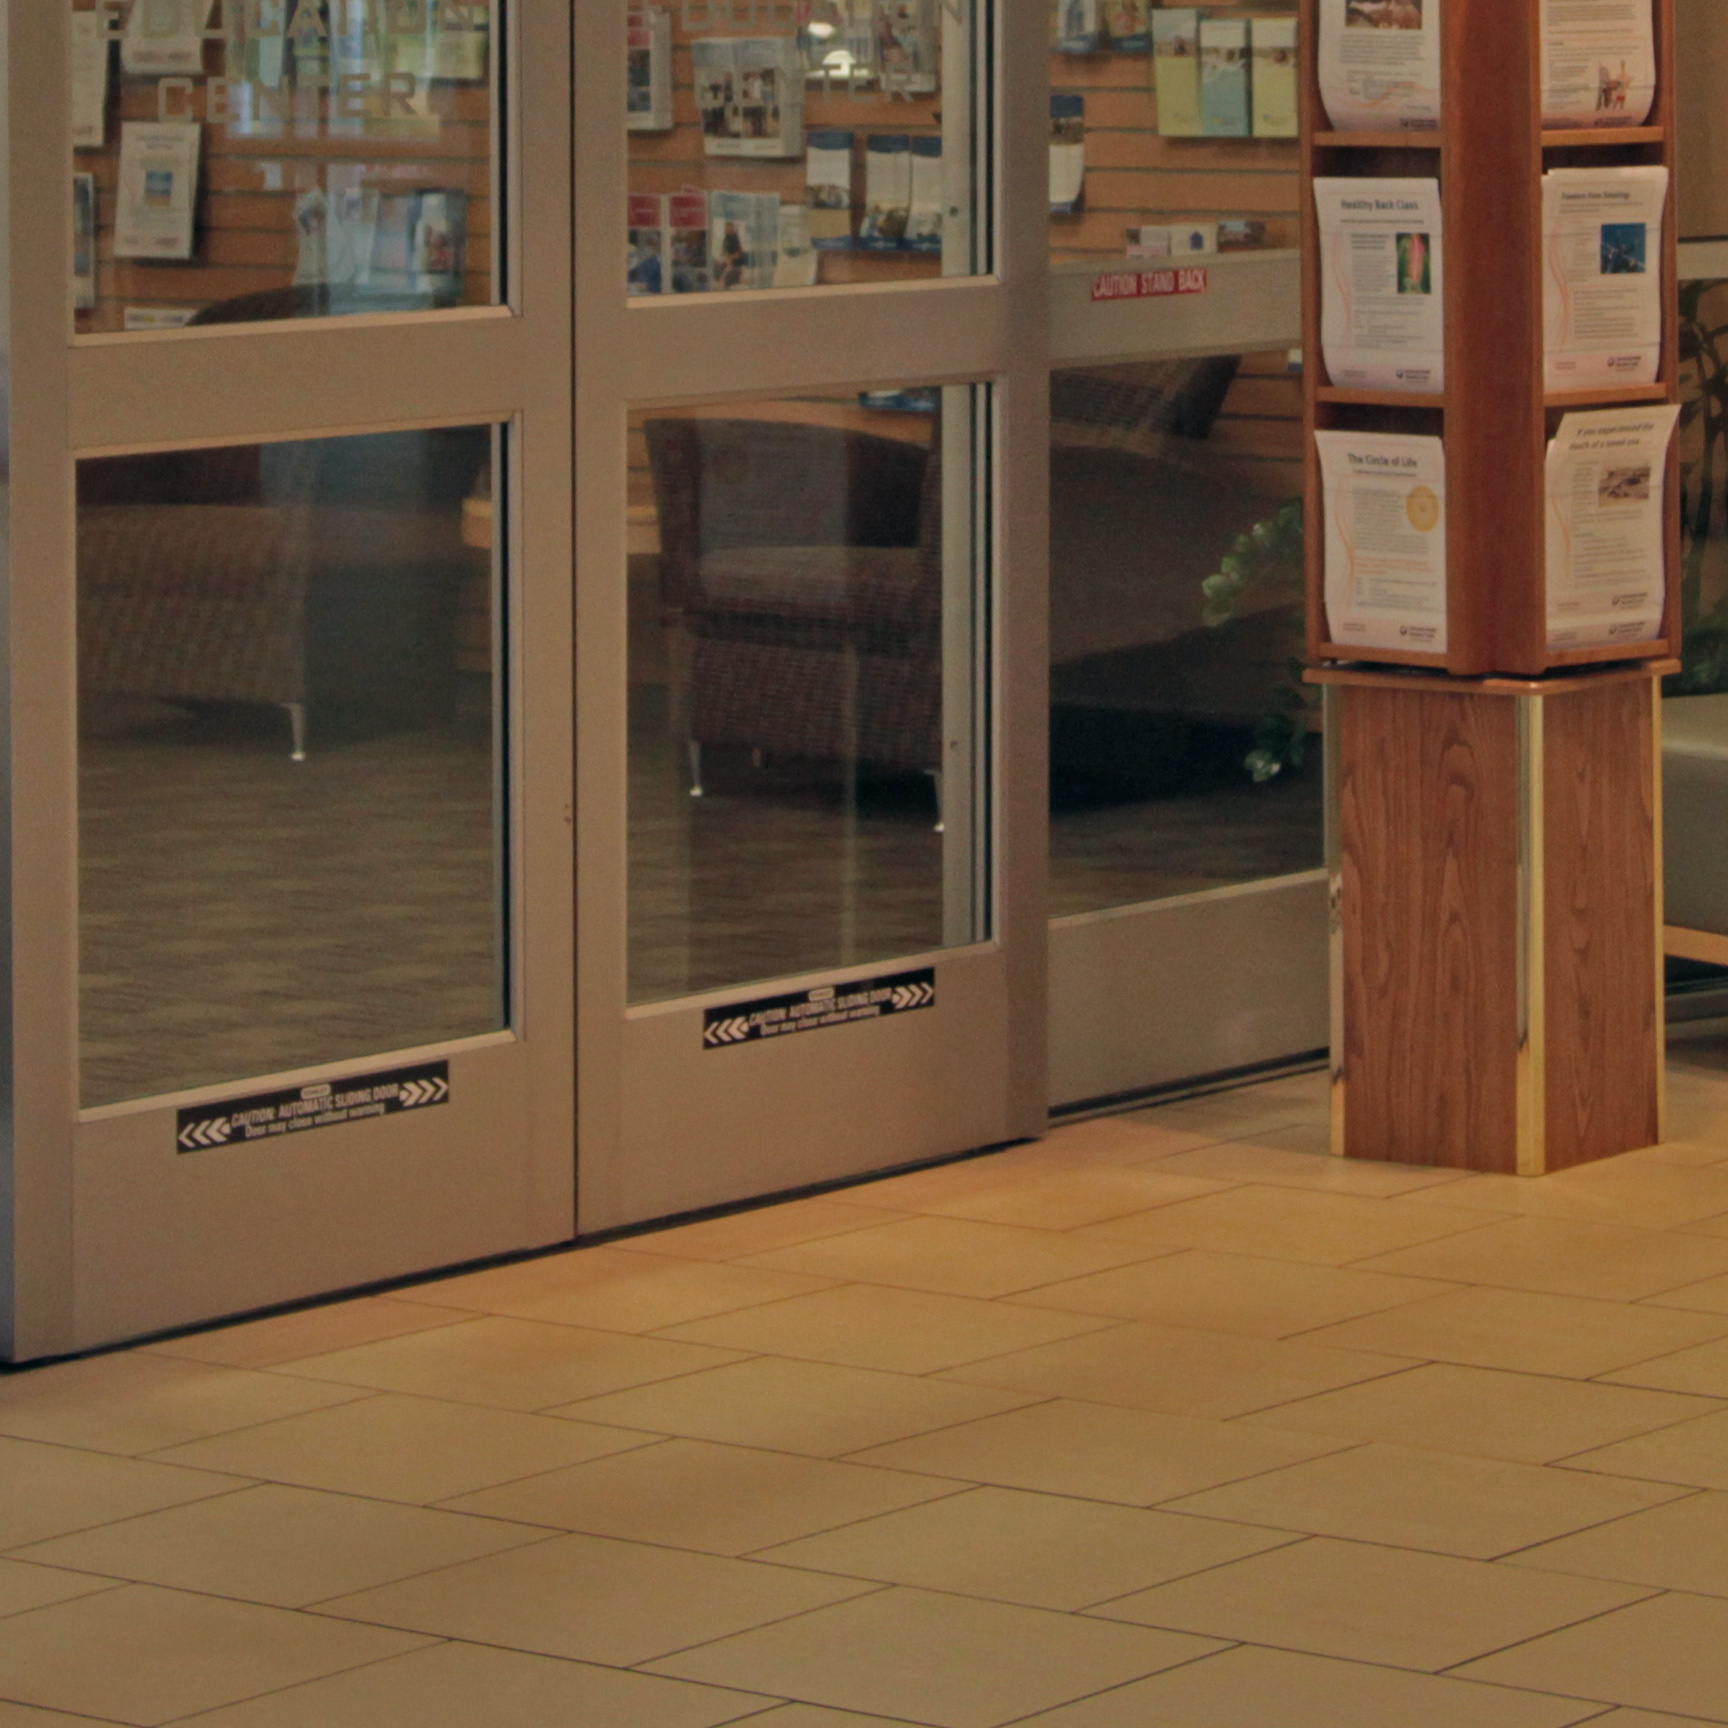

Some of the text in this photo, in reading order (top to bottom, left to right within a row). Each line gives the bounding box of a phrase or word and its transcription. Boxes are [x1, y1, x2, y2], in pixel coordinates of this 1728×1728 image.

[157, 72, 418, 123] CENTER
[1092, 269, 1206, 298] CAUTION STAND BACK
[278, 1097, 333, 1119] AUTOMATIC
[335, 1089, 371, 1108] SLIDING
